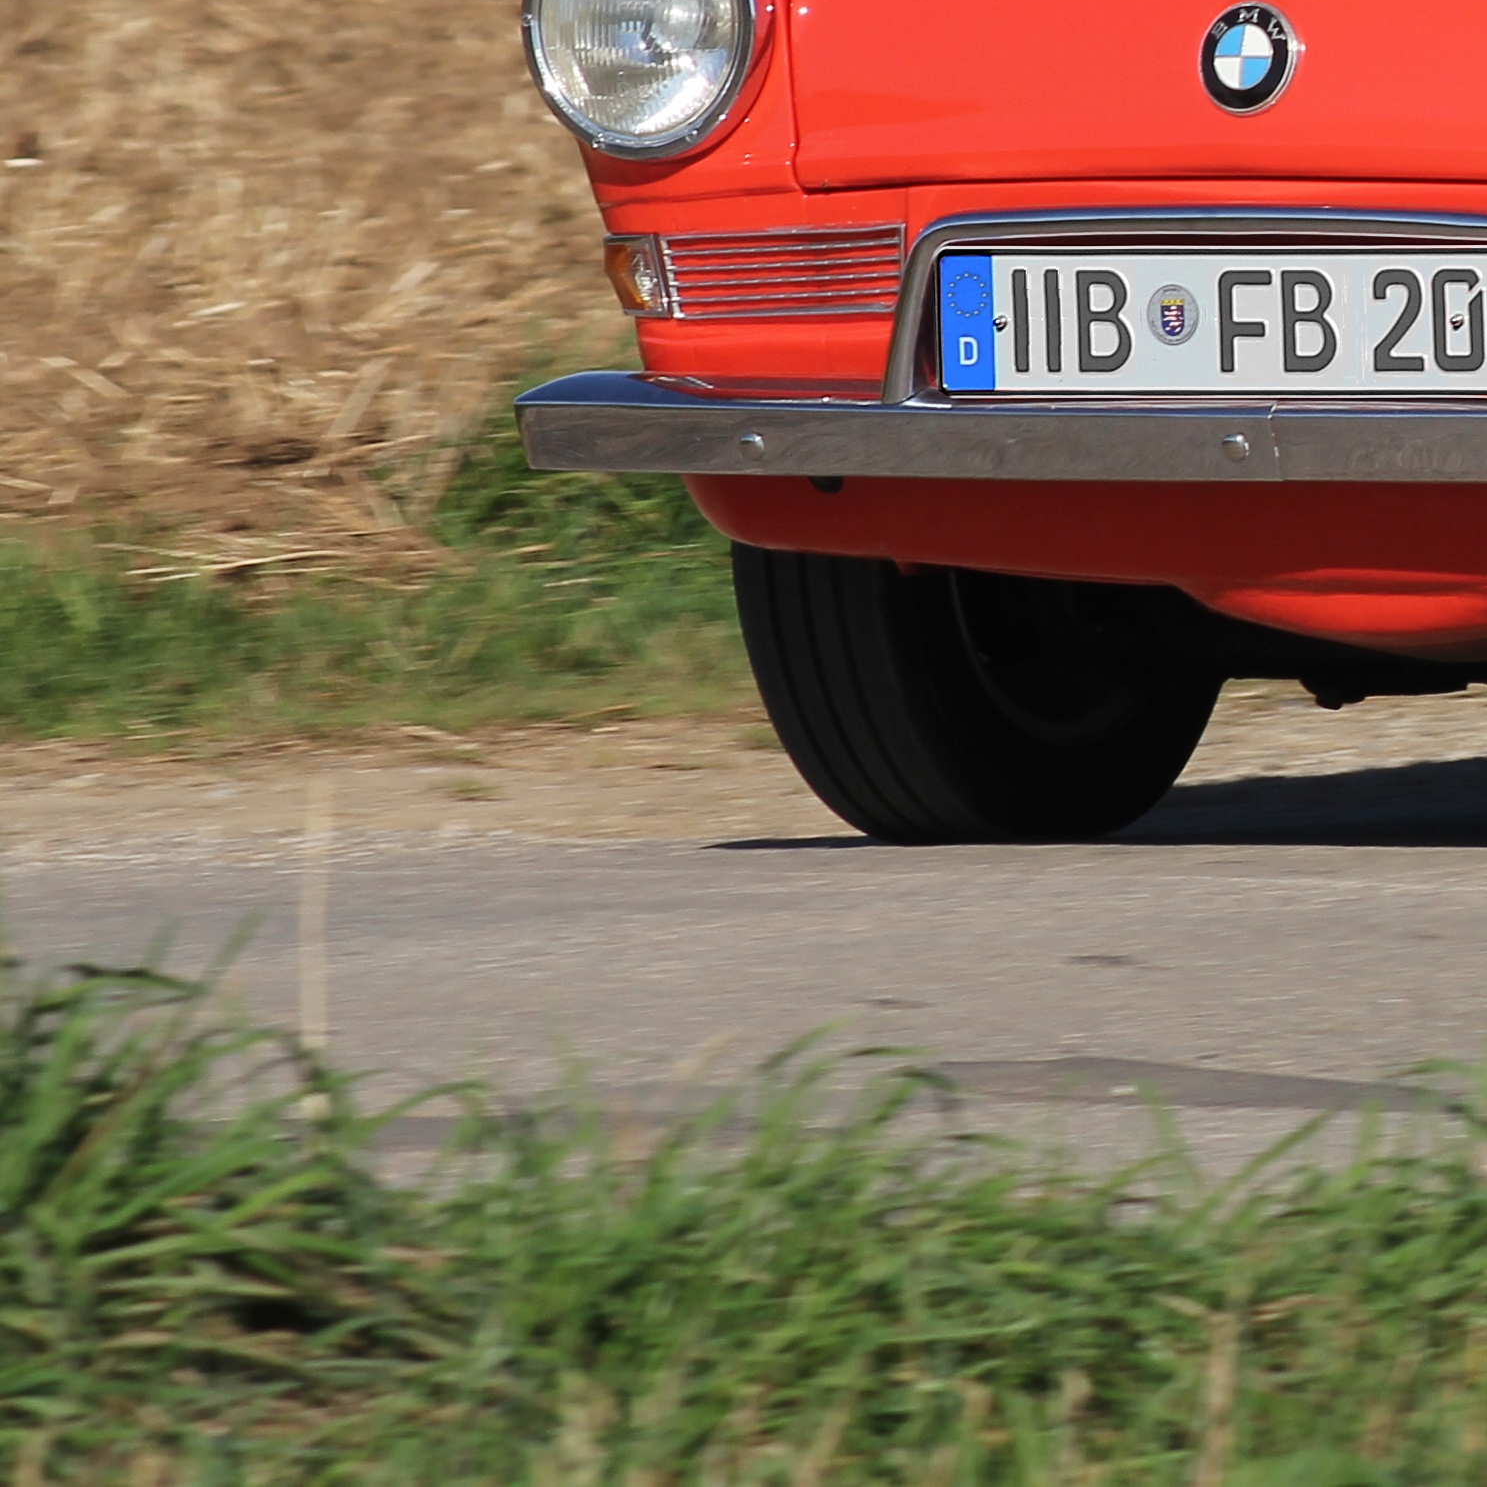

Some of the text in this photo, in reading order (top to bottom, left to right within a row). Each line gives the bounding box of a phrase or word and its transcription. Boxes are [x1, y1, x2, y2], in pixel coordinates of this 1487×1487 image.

[1212, 9, 1286, 41] BMW
[1219, 269, 1339, 374] FB
[1373, 269, 1487, 374] 20
[959, 336, 979, 365] D
